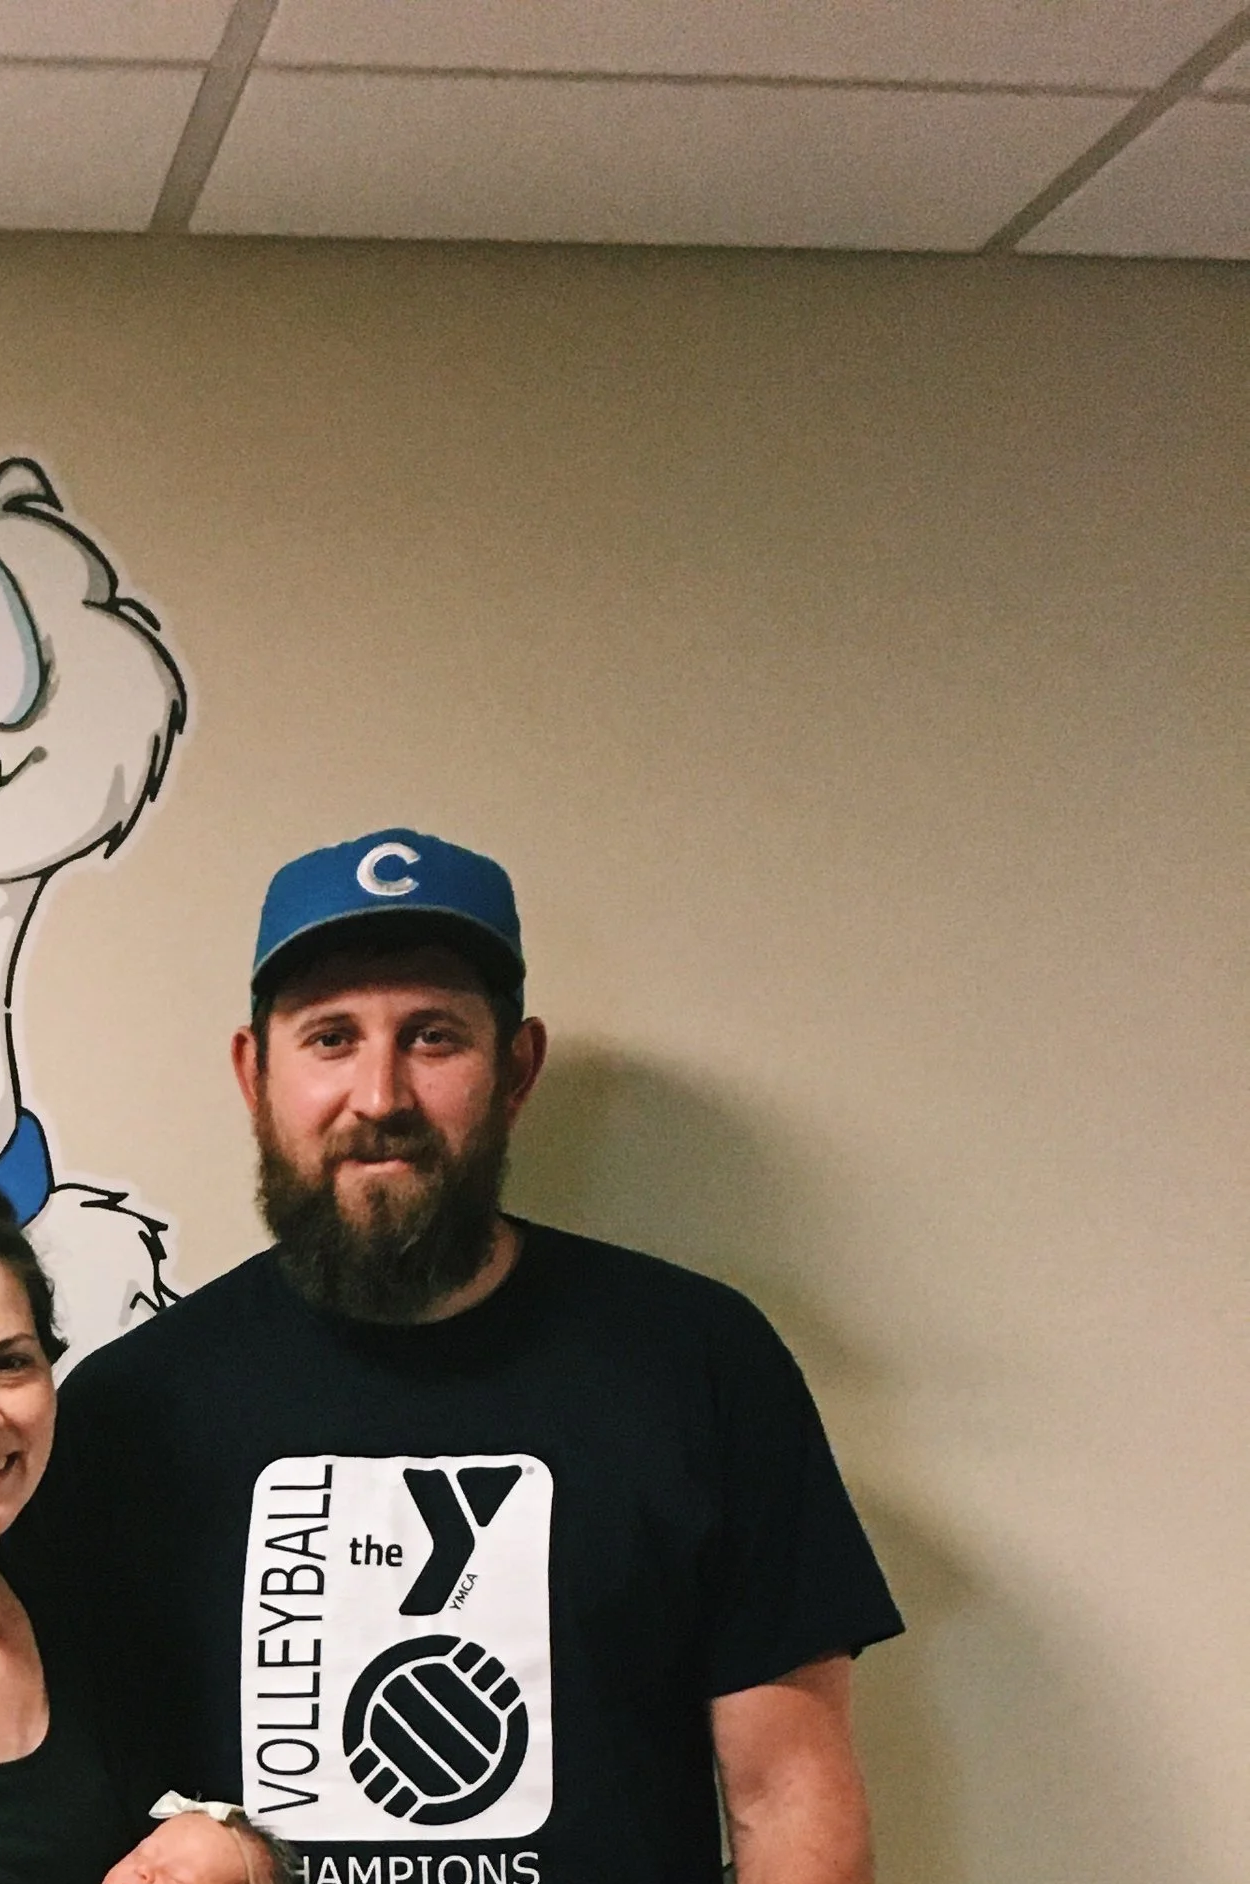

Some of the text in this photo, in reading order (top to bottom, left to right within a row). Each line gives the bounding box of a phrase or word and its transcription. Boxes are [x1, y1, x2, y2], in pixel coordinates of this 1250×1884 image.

[356, 842, 421, 896] C
[350, 1465, 523, 1616] the Y
[256, 1464, 333, 1814] VOLLEYBALL
[449, 1573, 479, 1611] YMCA
